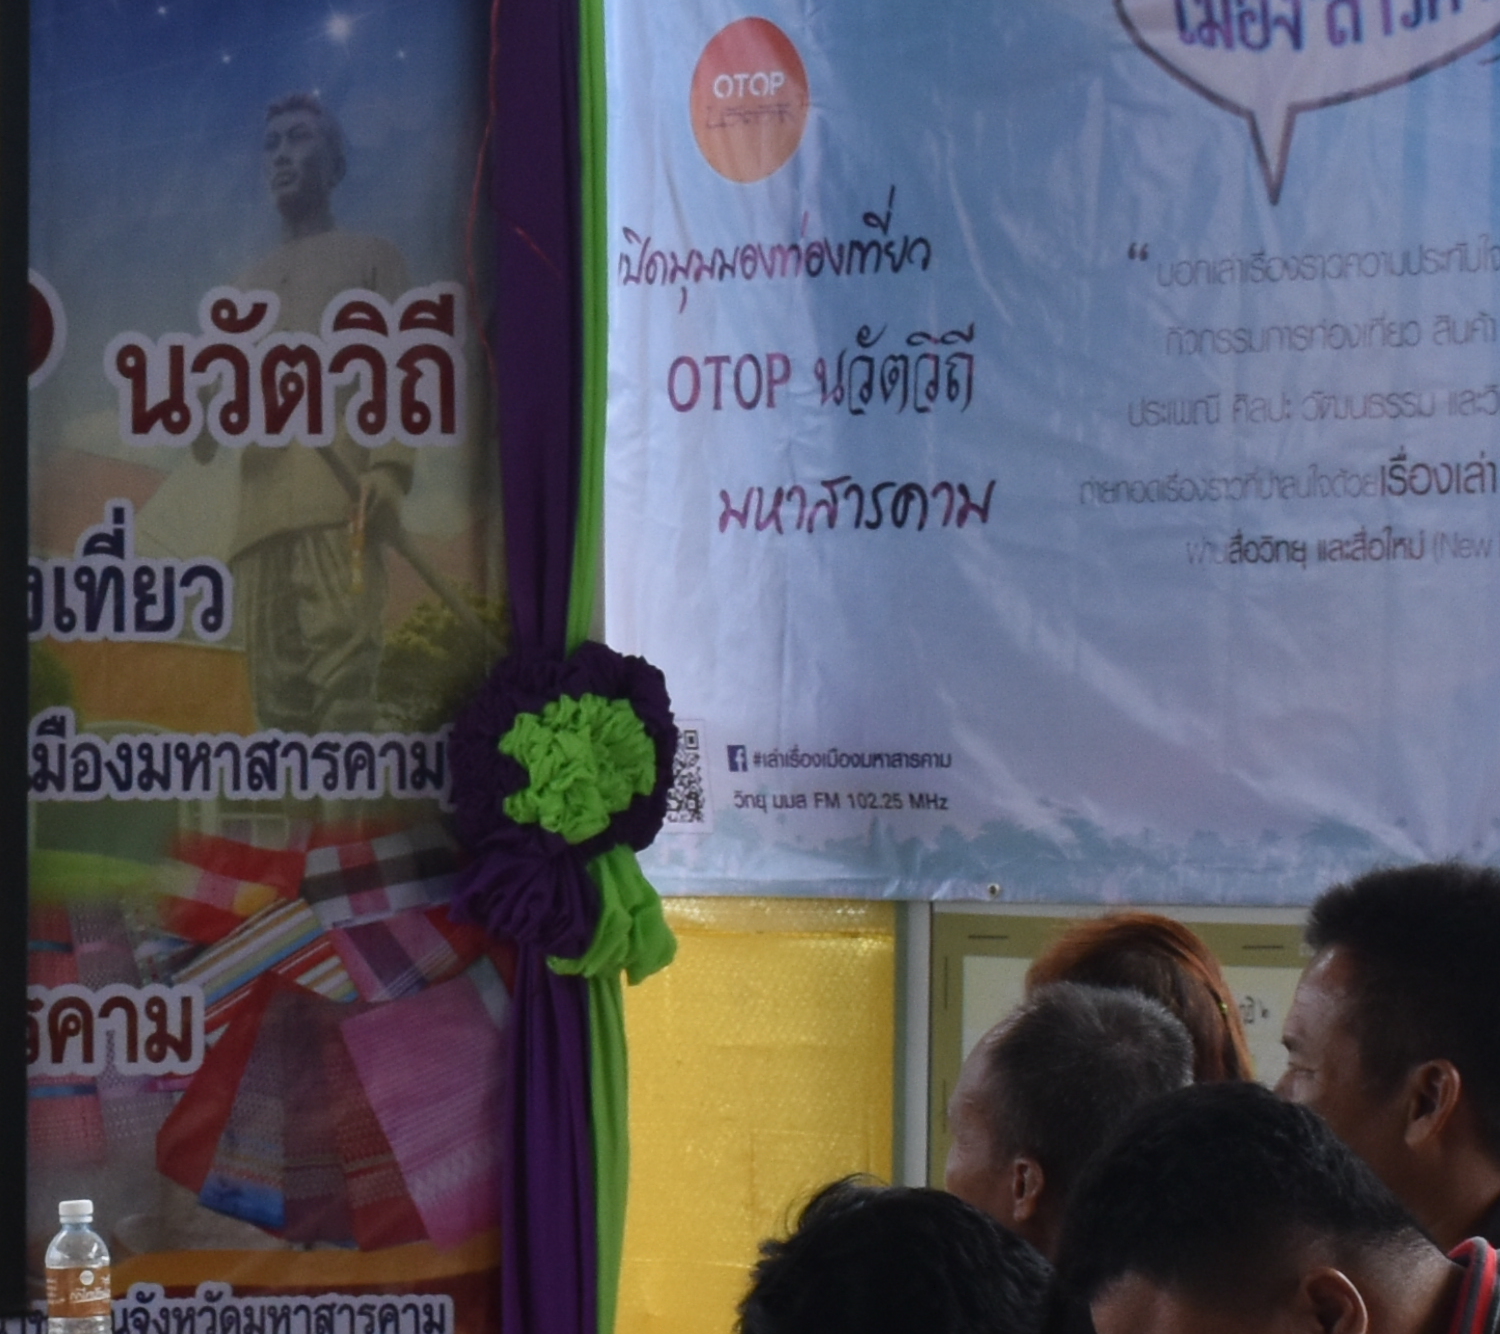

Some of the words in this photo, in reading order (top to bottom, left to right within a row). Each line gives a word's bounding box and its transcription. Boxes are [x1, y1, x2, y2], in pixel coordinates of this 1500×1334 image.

[712, 70, 787, 99] OTOP
[617, 186, 933, 313] เปิดมุมมองท่องเที่ยว
[1165, 313, 1422, 357] กิจกรรมการท่องเที่ยว
[1432, 315, 1497, 349] สินค้า
[114, 291, 458, 437] นวัตวิถี
[667, 351, 792, 413] OTOP
[814, 323, 977, 415] นวัตวิถี
[1127, 390, 1220, 428] ประเพณี
[1231, 387, 1292, 424] ศิลปะ
[719, 475, 997, 534] มหาสารคาม
[1432, 531, 1494, 563] (New
[753, 743, 953, 769] #เล่าเรื่องเมืองมหาสารคาม
[733, 790, 768, 814] วิทยุ
[814, 792, 841, 809] FM
[847, 792, 904, 810] 102.25
[908, 793, 950, 811] MHz
